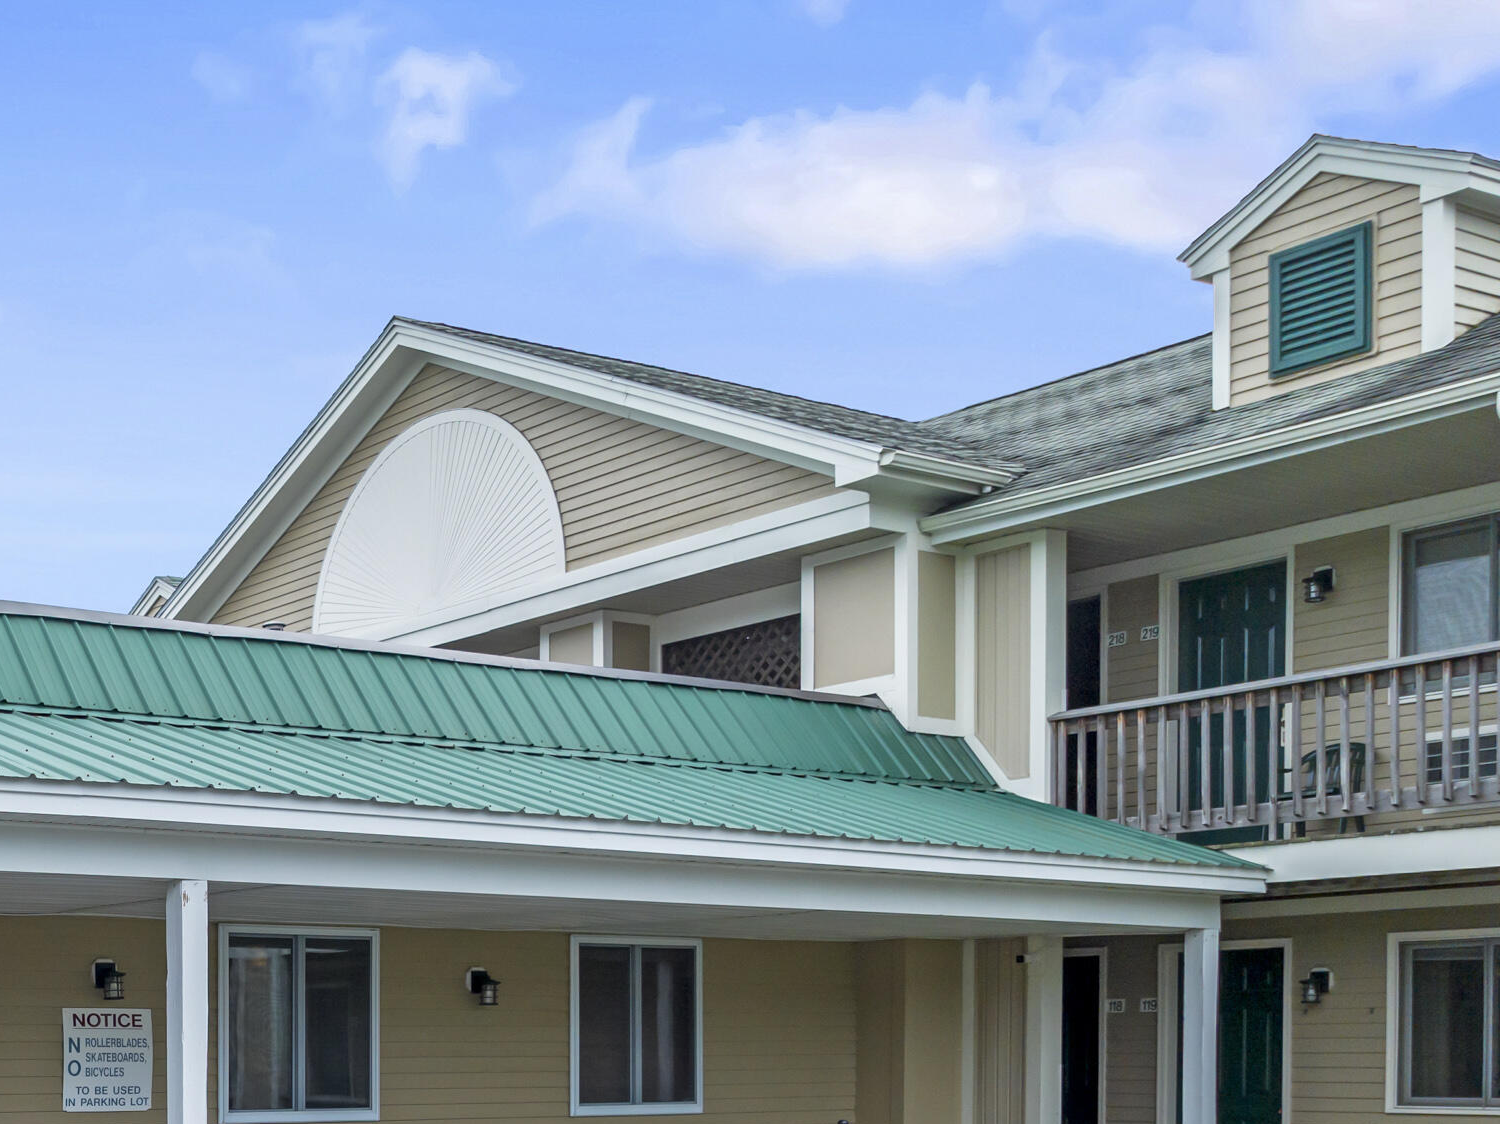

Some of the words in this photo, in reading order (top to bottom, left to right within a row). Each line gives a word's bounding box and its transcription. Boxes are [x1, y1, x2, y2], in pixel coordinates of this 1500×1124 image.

[1109, 633, 1124, 645] 218
[1143, 627, 1159, 640] 219
[1109, 1000, 1123, 1011] 118
[1142, 1000, 1157, 1011] 119
[72, 1013, 143, 1028] NOTICE
[85, 1038, 149, 1049] ROLLERBLADES,
[85, 1053, 147, 1064] SKATEBOARDS,
[85, 1067, 124, 1077] BICYCLES
[76, 1086, 90, 1095] TO
[94, 1086, 108, 1095] BE
[113, 1086, 141, 1095] USED
[65, 1098, 76, 1107] IN
[80, 1098, 126, 1107] PARKING
[130, 1098, 149, 1106] LOT
